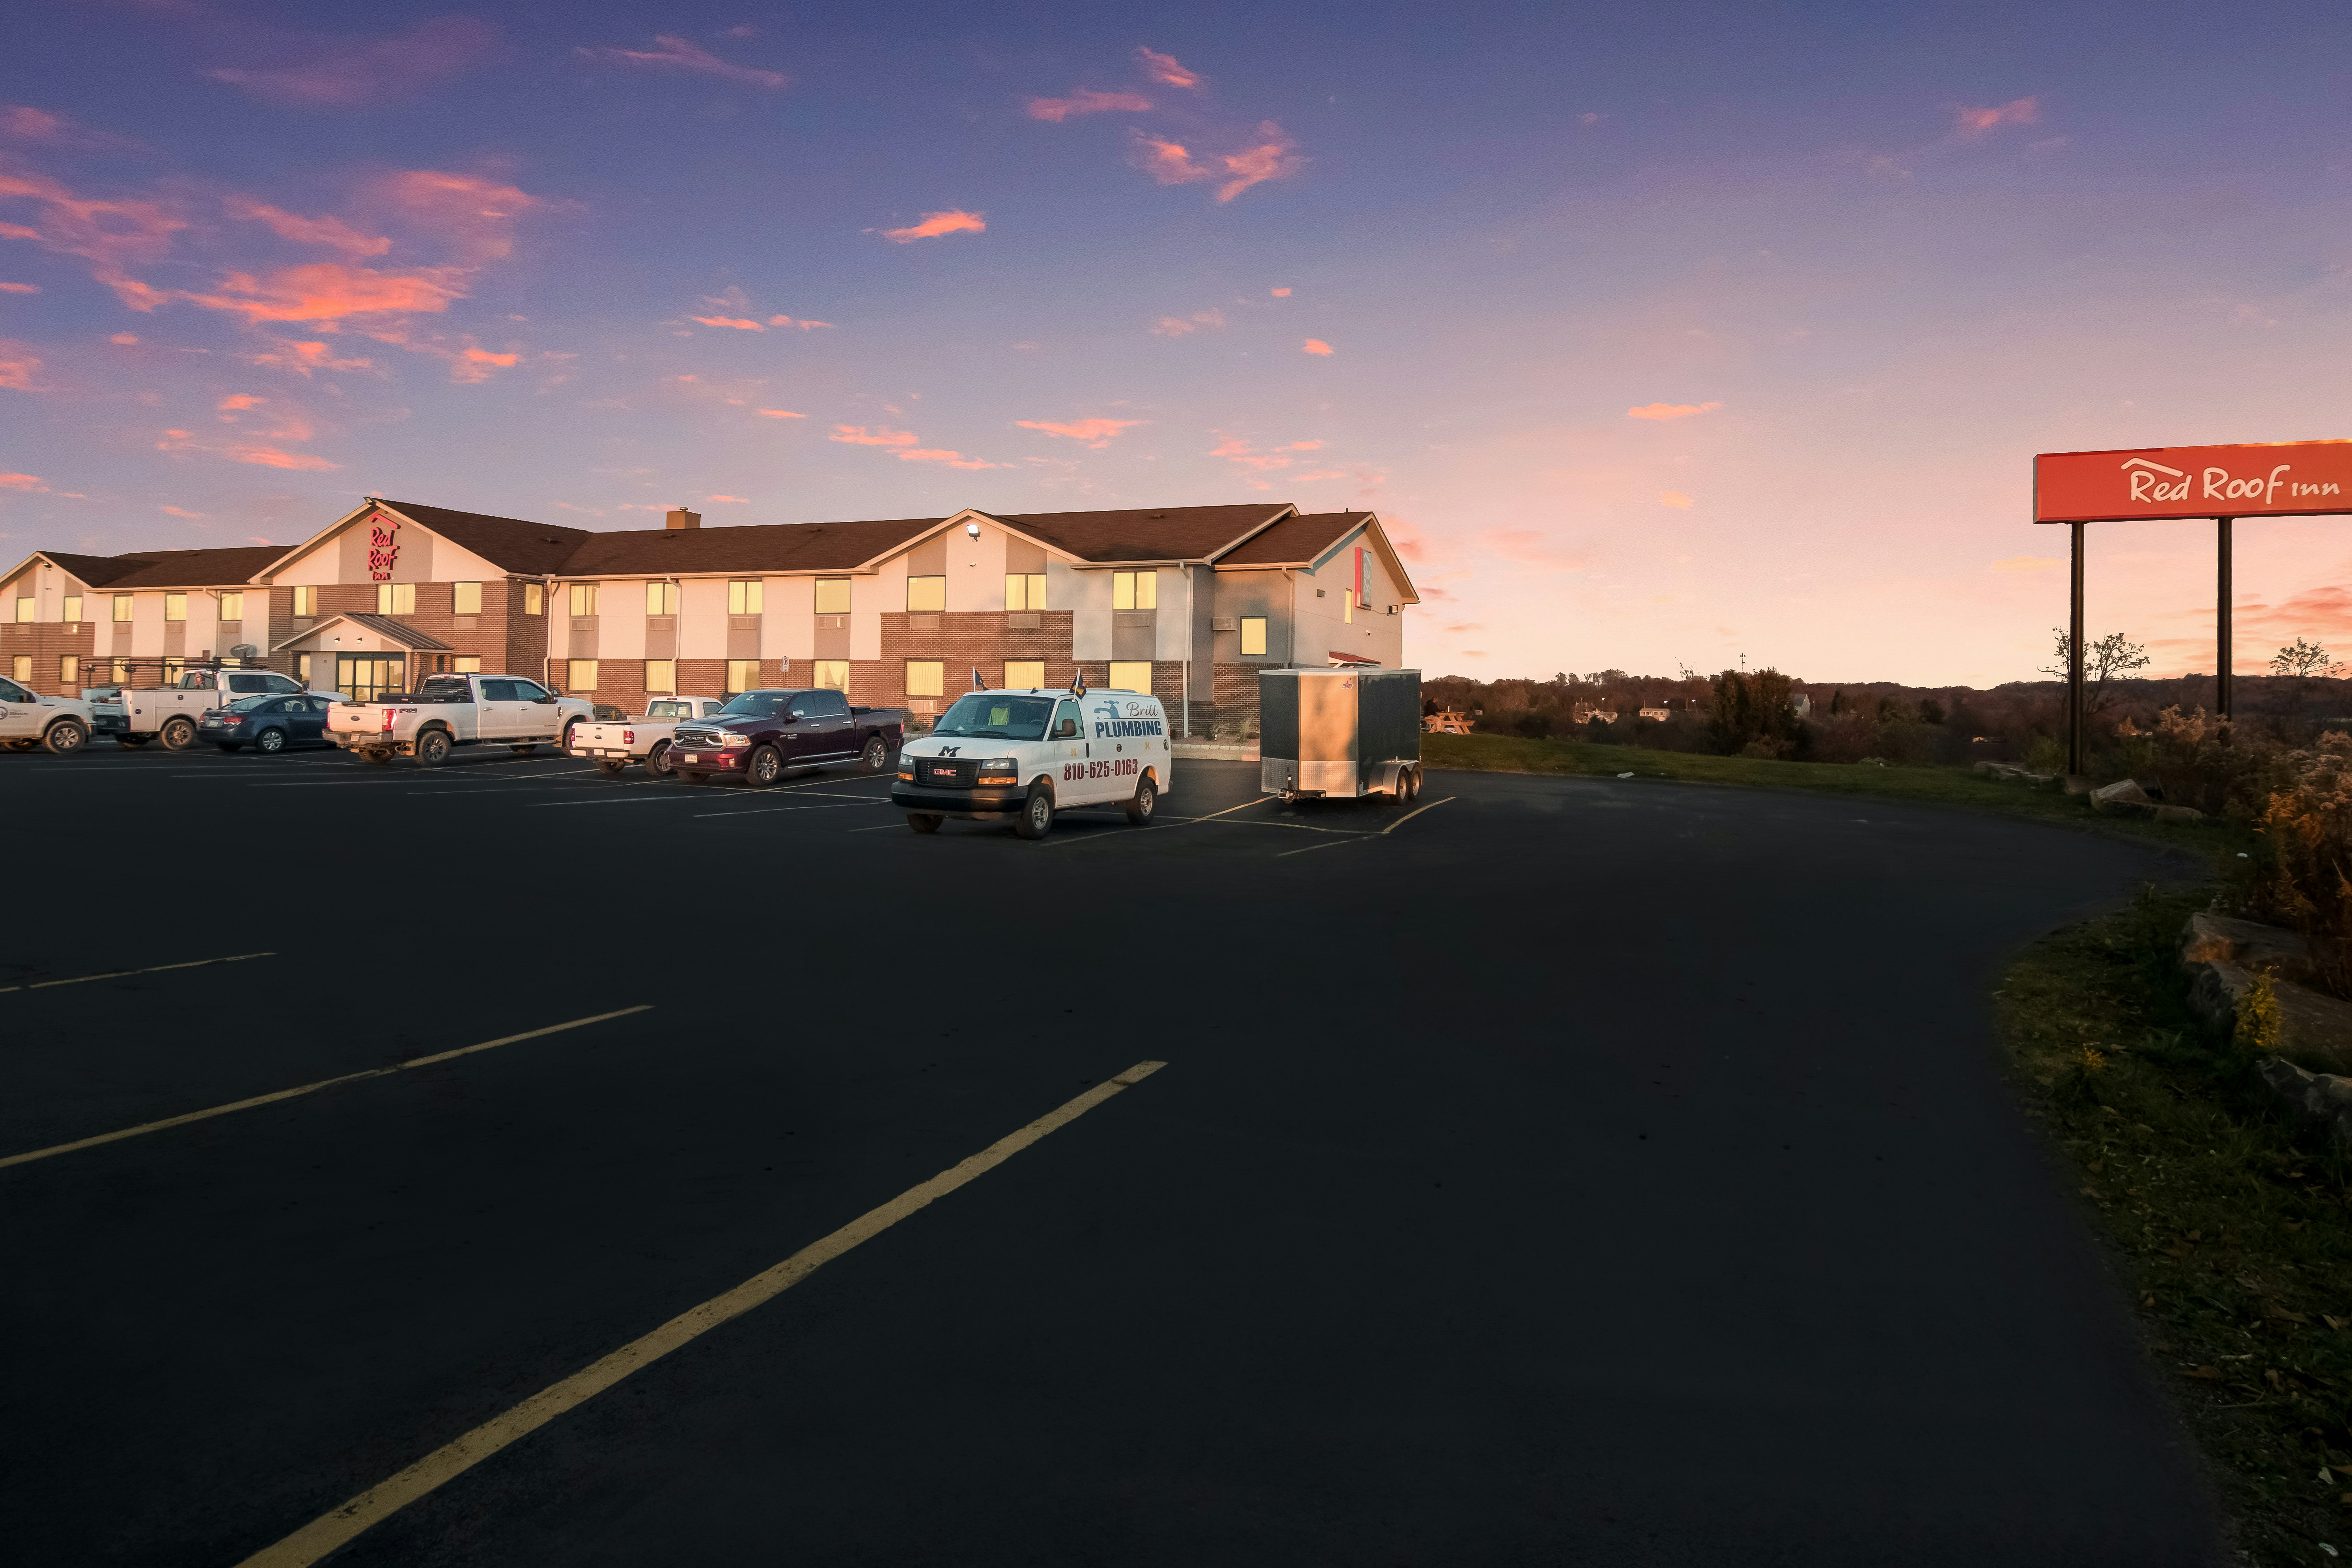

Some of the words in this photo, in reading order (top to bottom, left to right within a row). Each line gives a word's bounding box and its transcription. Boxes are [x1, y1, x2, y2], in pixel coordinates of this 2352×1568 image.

[2130, 470, 2192, 503] Red
[2203, 465, 2290, 504] Roof
[371, 526, 395, 547] Red
[368, 545, 400, 571] Roof
[1126, 702, 1158, 717] Brill
[1095, 721, 1162, 738] PLUMBING
[938, 746, 961, 757] M
[1064, 758, 1138, 781] 810-625-0163
